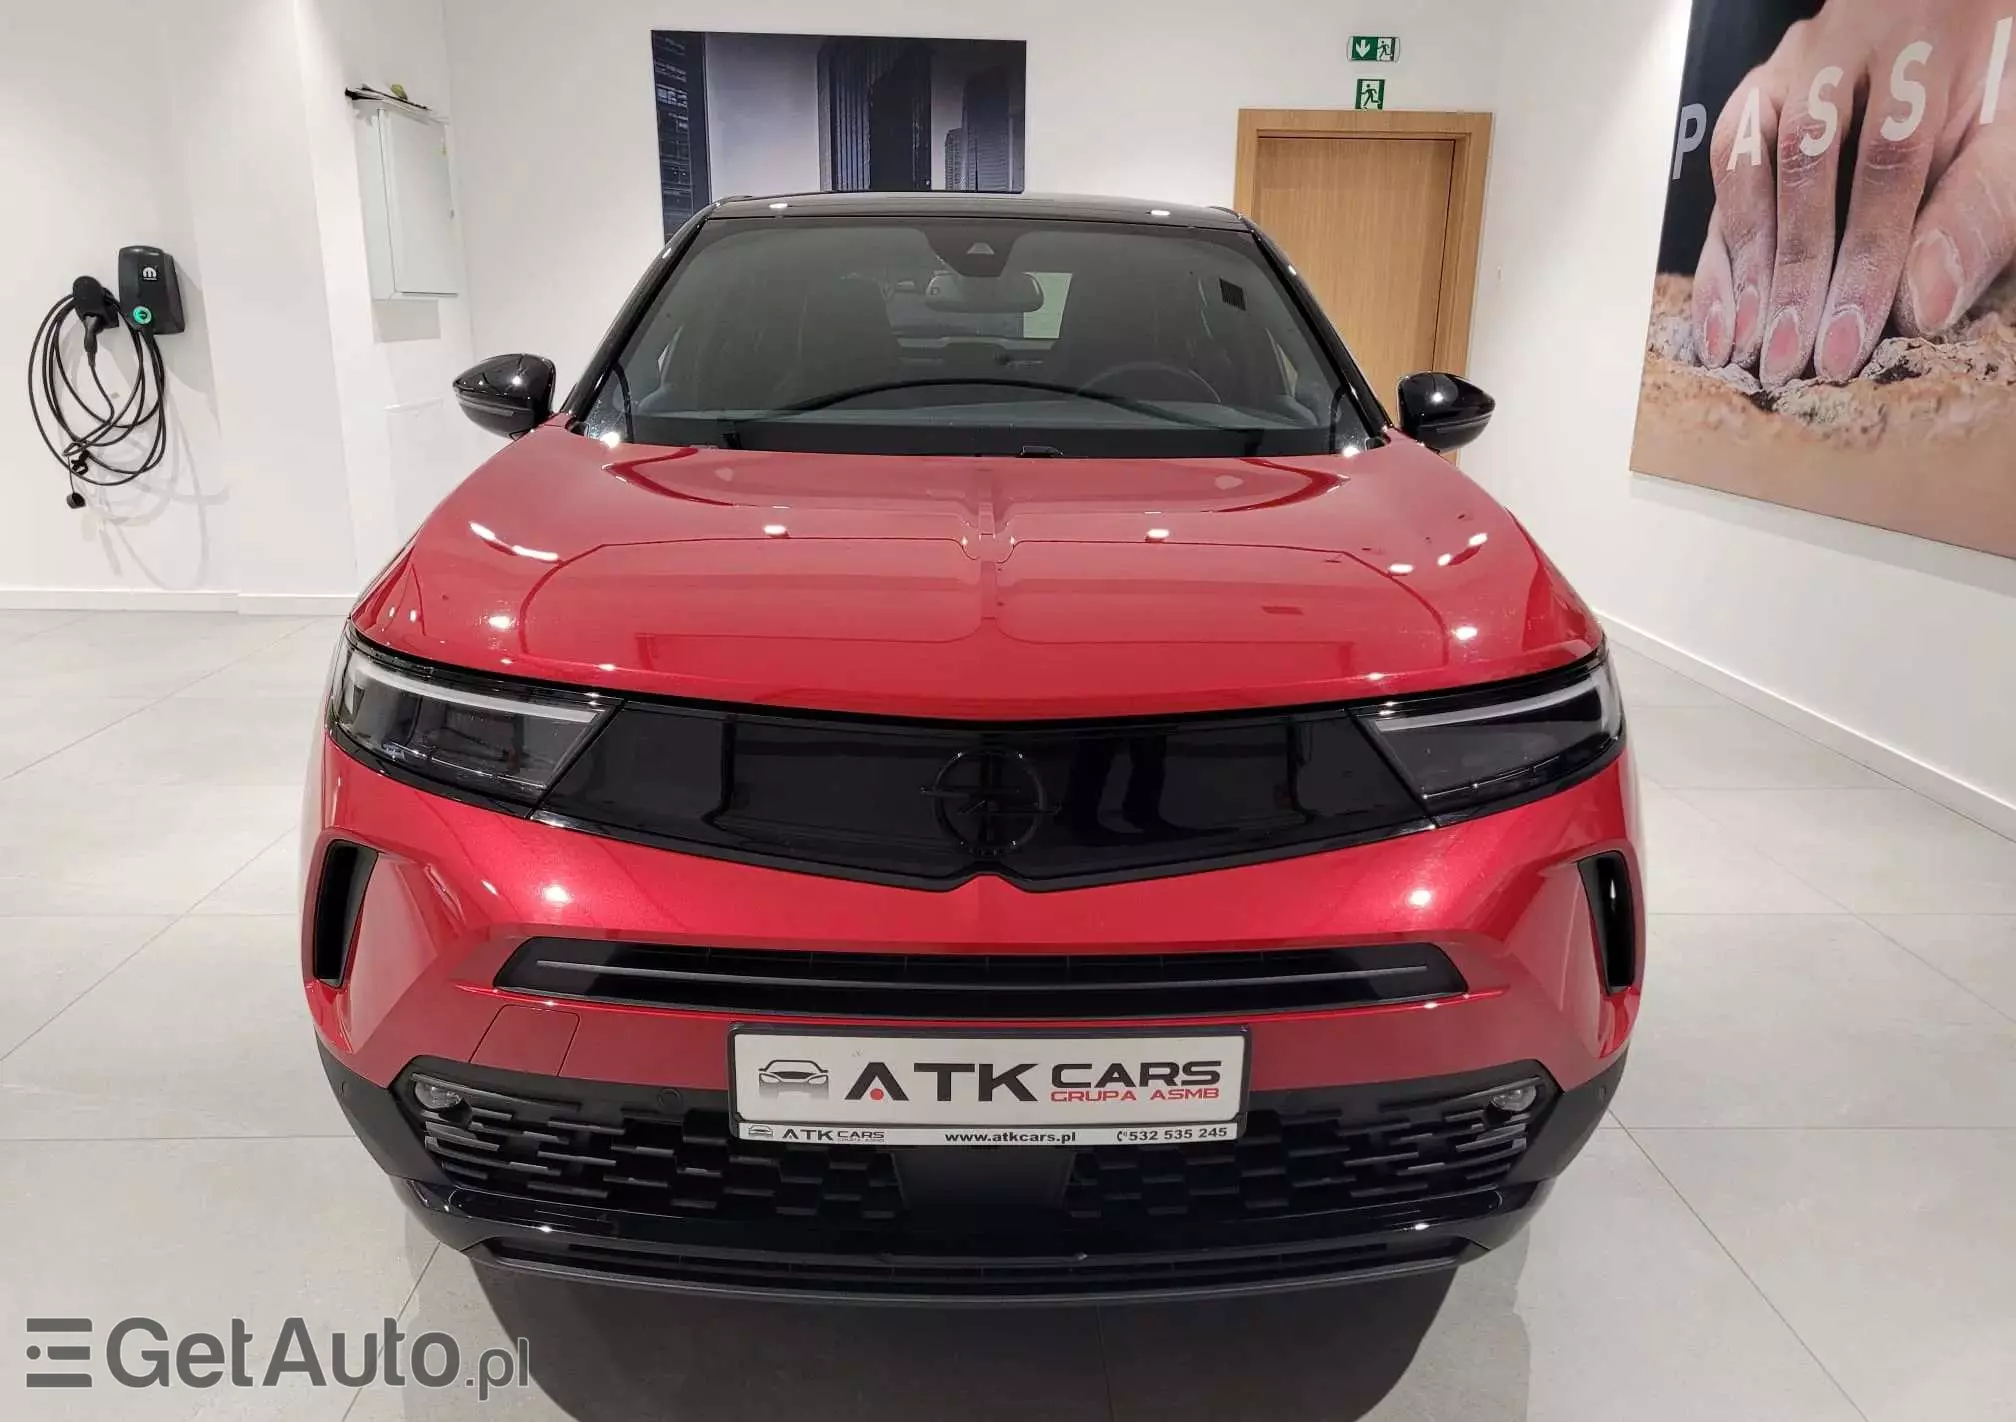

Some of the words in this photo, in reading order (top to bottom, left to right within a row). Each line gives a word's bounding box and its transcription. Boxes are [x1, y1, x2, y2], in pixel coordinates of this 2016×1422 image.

[1672, 16, 2014, 180] PASSI
[844, 1061, 1039, 1102] ATK
[1051, 1060, 1222, 1088] CARS
[1050, 1088, 1137, 1102] GRUPA
[1150, 1087, 1220, 1100] ASMB
[782, 1128, 834, 1141] ATK
[837, 1130, 885, 1139] CARS
[945, 1132, 1076, 1143] www.atkcars.pl
[1128, 1130, 1158, 1141] 532
[1164, 1129, 1193, 1140] 535
[1198, 1127, 1228, 1138] 245
